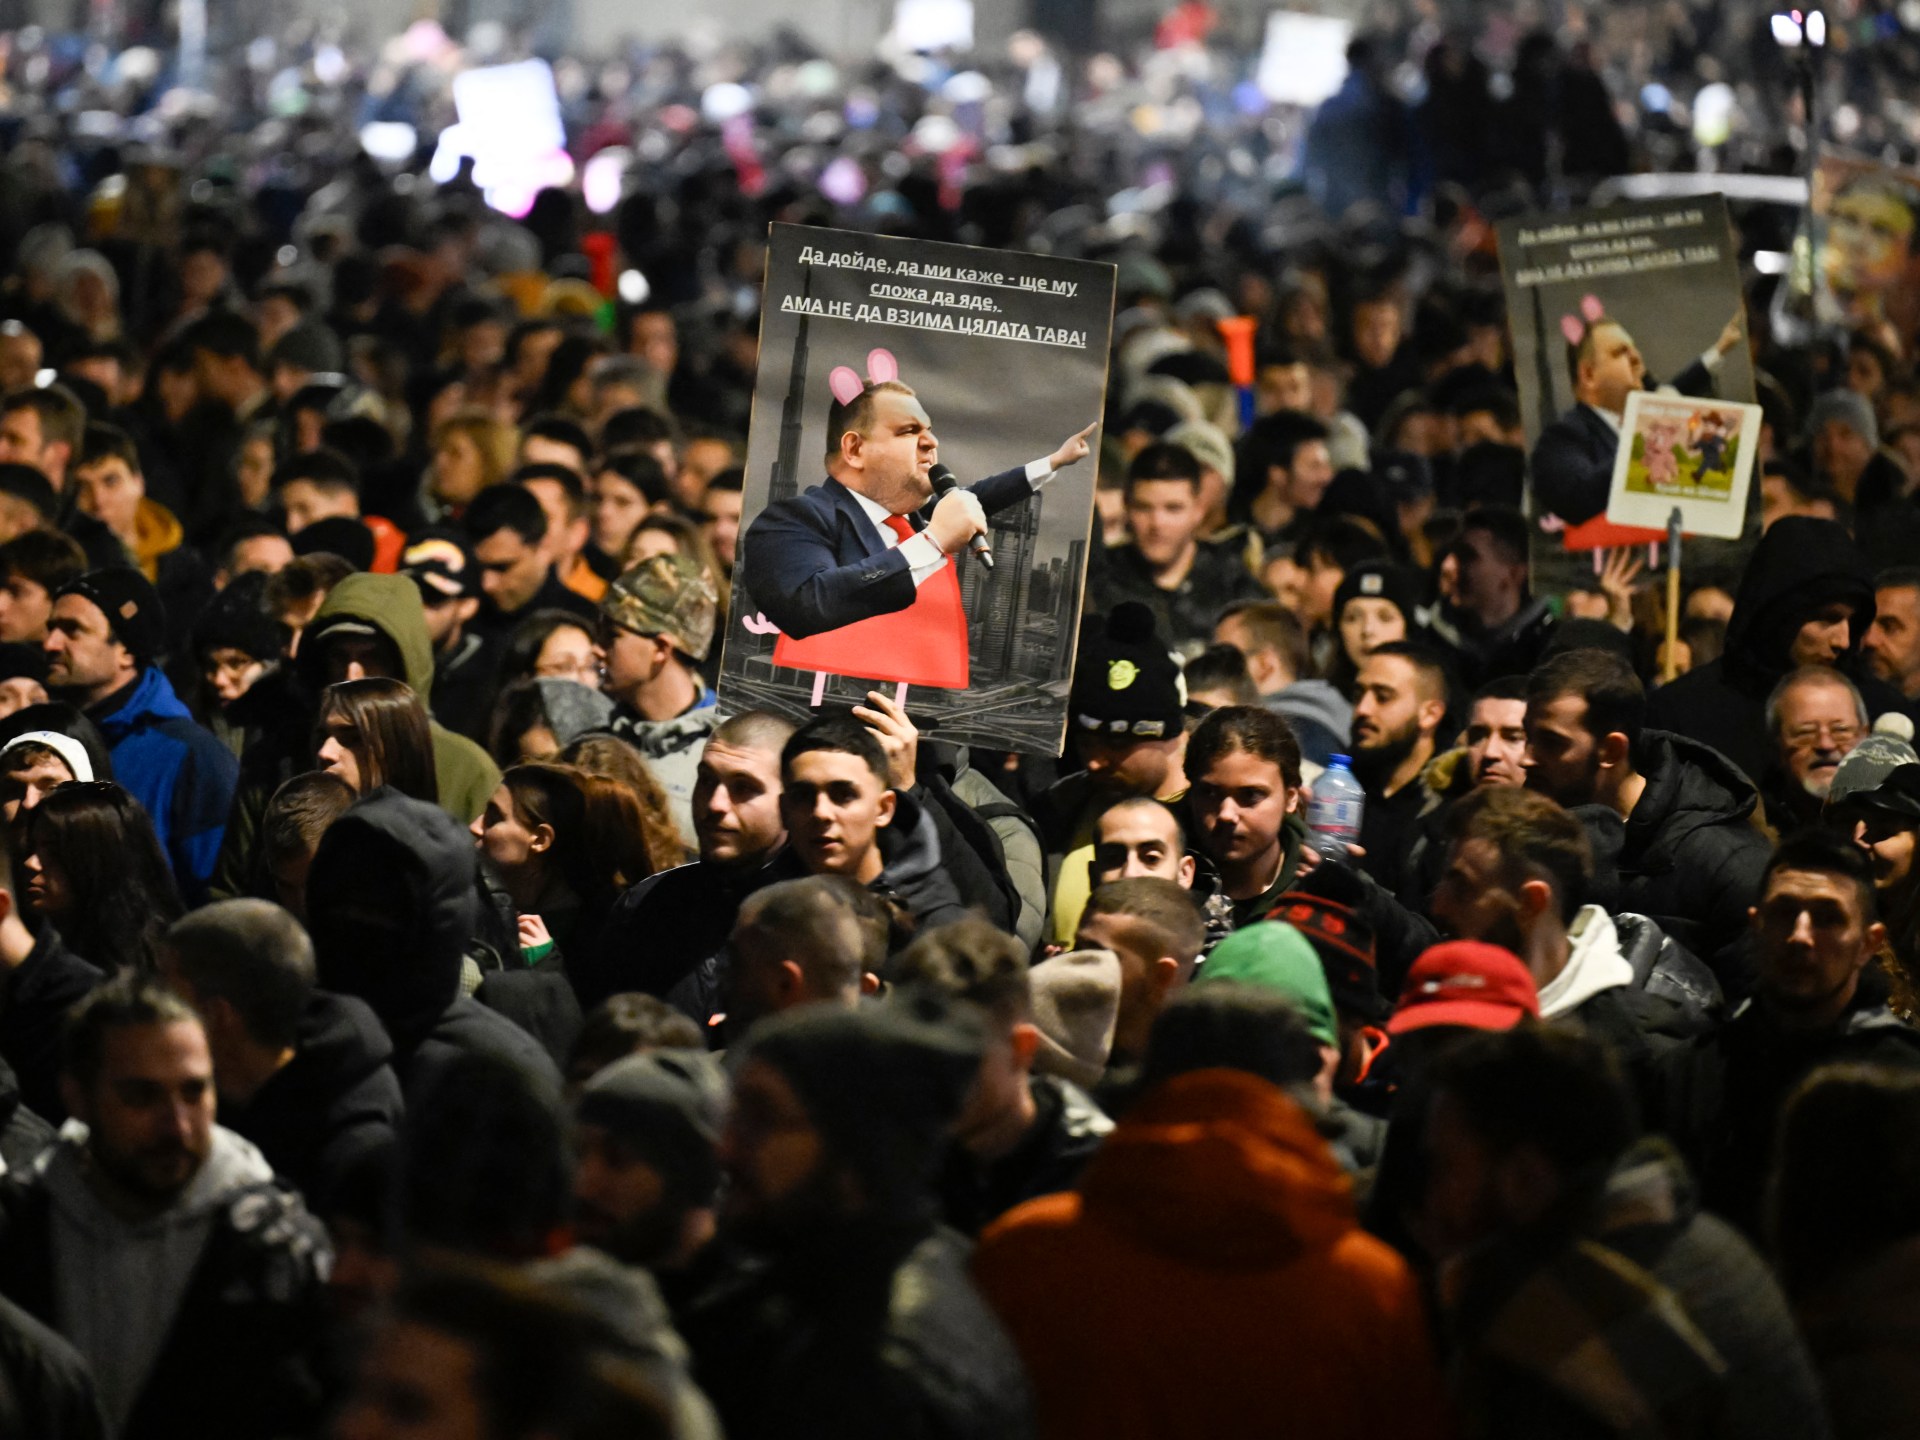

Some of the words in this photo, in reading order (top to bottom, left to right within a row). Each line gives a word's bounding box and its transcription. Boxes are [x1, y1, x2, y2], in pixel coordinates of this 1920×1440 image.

[798, 246, 824, 265] Да
[827, 251, 892, 274] дойде,
[895, 260, 919, 277] да
[923, 264, 952, 279] ми
[956, 267, 1004, 285] каже
[1019, 275, 1048, 292] ще
[870, 283, 928, 302] сложа
[931, 291, 955, 307] да
[959, 294, 998, 313] яде,
[781, 295, 824, 314] АМА
[828, 300, 852, 318] НЕ
[854, 304, 882, 323] ДА
[886, 307, 954, 331] ВЗИМА
[958, 316, 1031, 339] ЦЯЛАТА
[1035, 326, 1087, 348] ТАВА!
